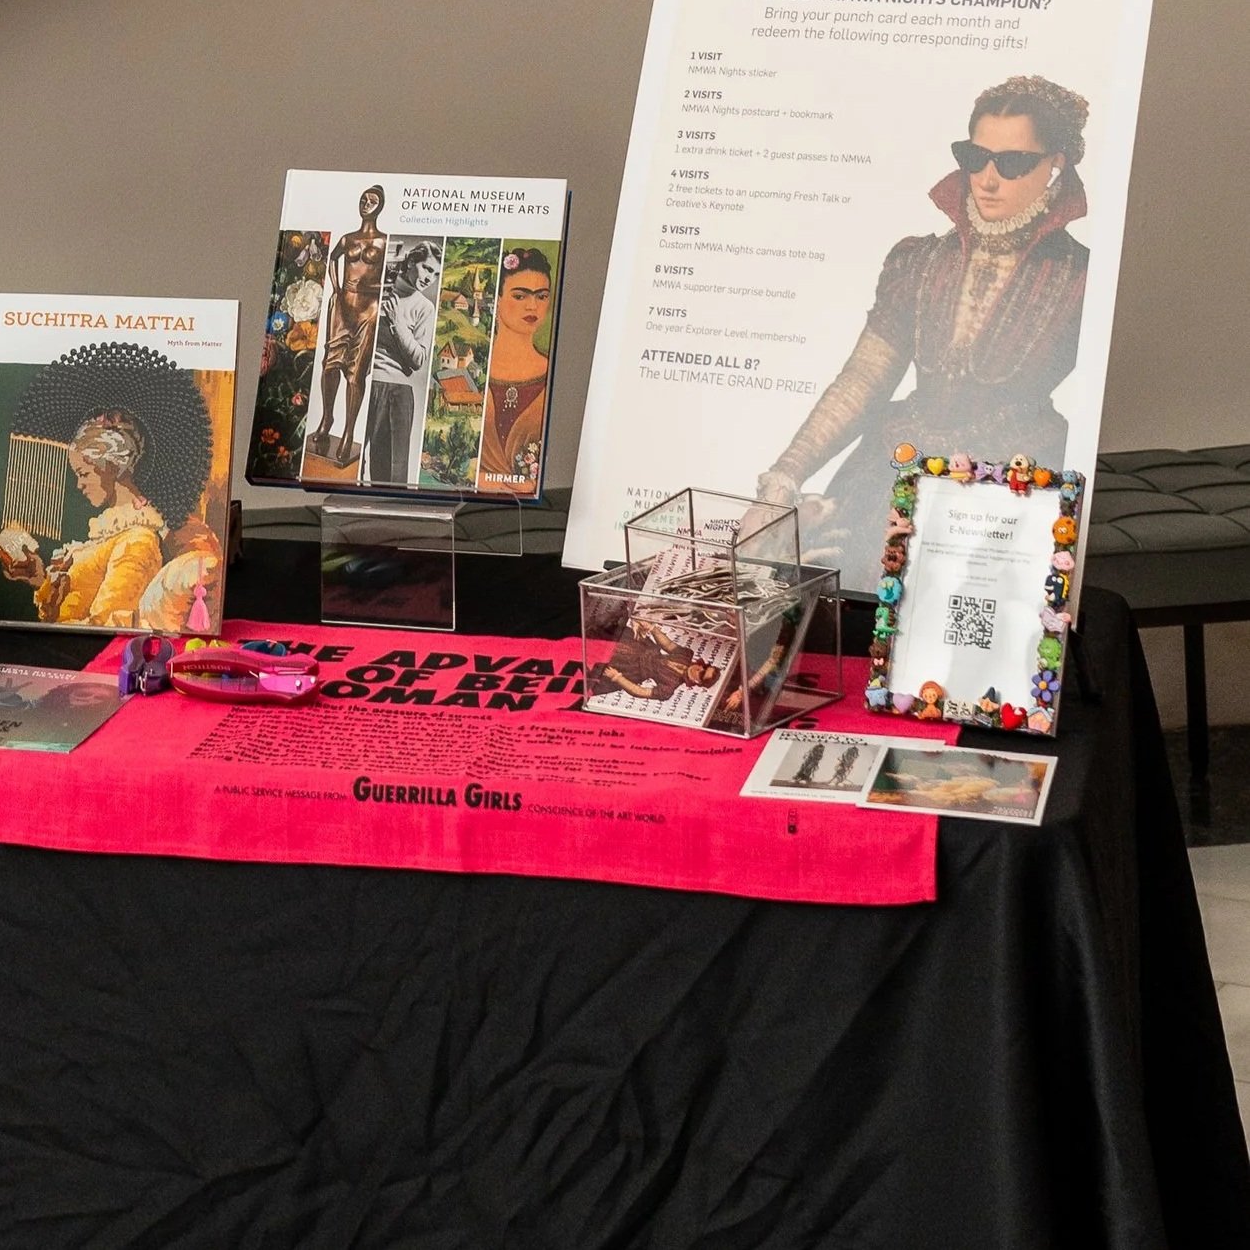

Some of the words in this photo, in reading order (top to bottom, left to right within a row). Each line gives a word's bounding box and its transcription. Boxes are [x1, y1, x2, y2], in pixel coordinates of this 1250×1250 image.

[690, 51, 695, 60] 1
[698, 51, 723, 61] VISIT
[683, 89, 690, 98] 2
[692, 90, 722, 100] VISITS
[677, 130, 683, 139] 3
[685, 130, 716, 140] VISITS
[670, 169, 677, 178] 4
[679, 169, 709, 180] VISITS
[403, 187, 465, 199] NATIONAL
[470, 190, 525, 201] MUSEUM
[401, 200, 418, 210] OF
[421, 201, 469, 212] WOMEN
[473, 203, 486, 213] IN
[490, 203, 514, 213] THE
[517, 204, 549, 215] ARTS
[399, 214, 443, 224] Collection
[445, 217, 488, 227] Highlights
[661, 224, 667, 233] 5
[669, 225, 700, 236] VISITS
[663, 264, 694, 276] VISITS
[652, 278, 681, 290] NMWA
[683, 283, 727, 293] supporter
[727, 286, 764, 297] surprise
[765, 288, 796, 299] bundle
[648, 306, 654, 315] 7
[656, 306, 687, 318] VISITS
[4, 311, 109, 328] SUCHITRA
[114, 314, 195, 331] MATTAI
[167, 339, 184, 347] Myth
[640, 349, 712, 366] ATTENDED
[714, 355, 740, 369] ALL
[744, 357, 760, 371] 8?
[639, 365, 661, 380] The
[663, 368, 725, 386] ULTIMATE
[727, 374, 773, 390] GRAND
[775, 378, 817, 394] PRIZE!
[485, 474, 527, 484] HIRMER
[948, 509, 968, 521] Sign
[970, 513, 984, 526] up
[985, 512, 999, 524] for
[1000, 516, 1019, 526] our
[346, 665, 436, 687] OF
[455, 673, 584, 694] BEI
[319, 680, 539, 712] OMAN
[214, 785, 221, 793] A
[222, 784, 250, 796] PUBLIC
[251, 787, 283, 798] SERVICE
[284, 789, 322, 800] MESSAGE
[323, 791, 347, 801] FROM
[352, 775, 457, 807] GUERRILLA
[463, 782, 522, 812] GIRLS
[527, 803, 583, 817] CONSCIENCE
[585, 808, 599, 819] OF
[599, 809, 614, 820] THE
[616, 811, 632, 821] ART
[633, 813, 665, 824] WORLD
